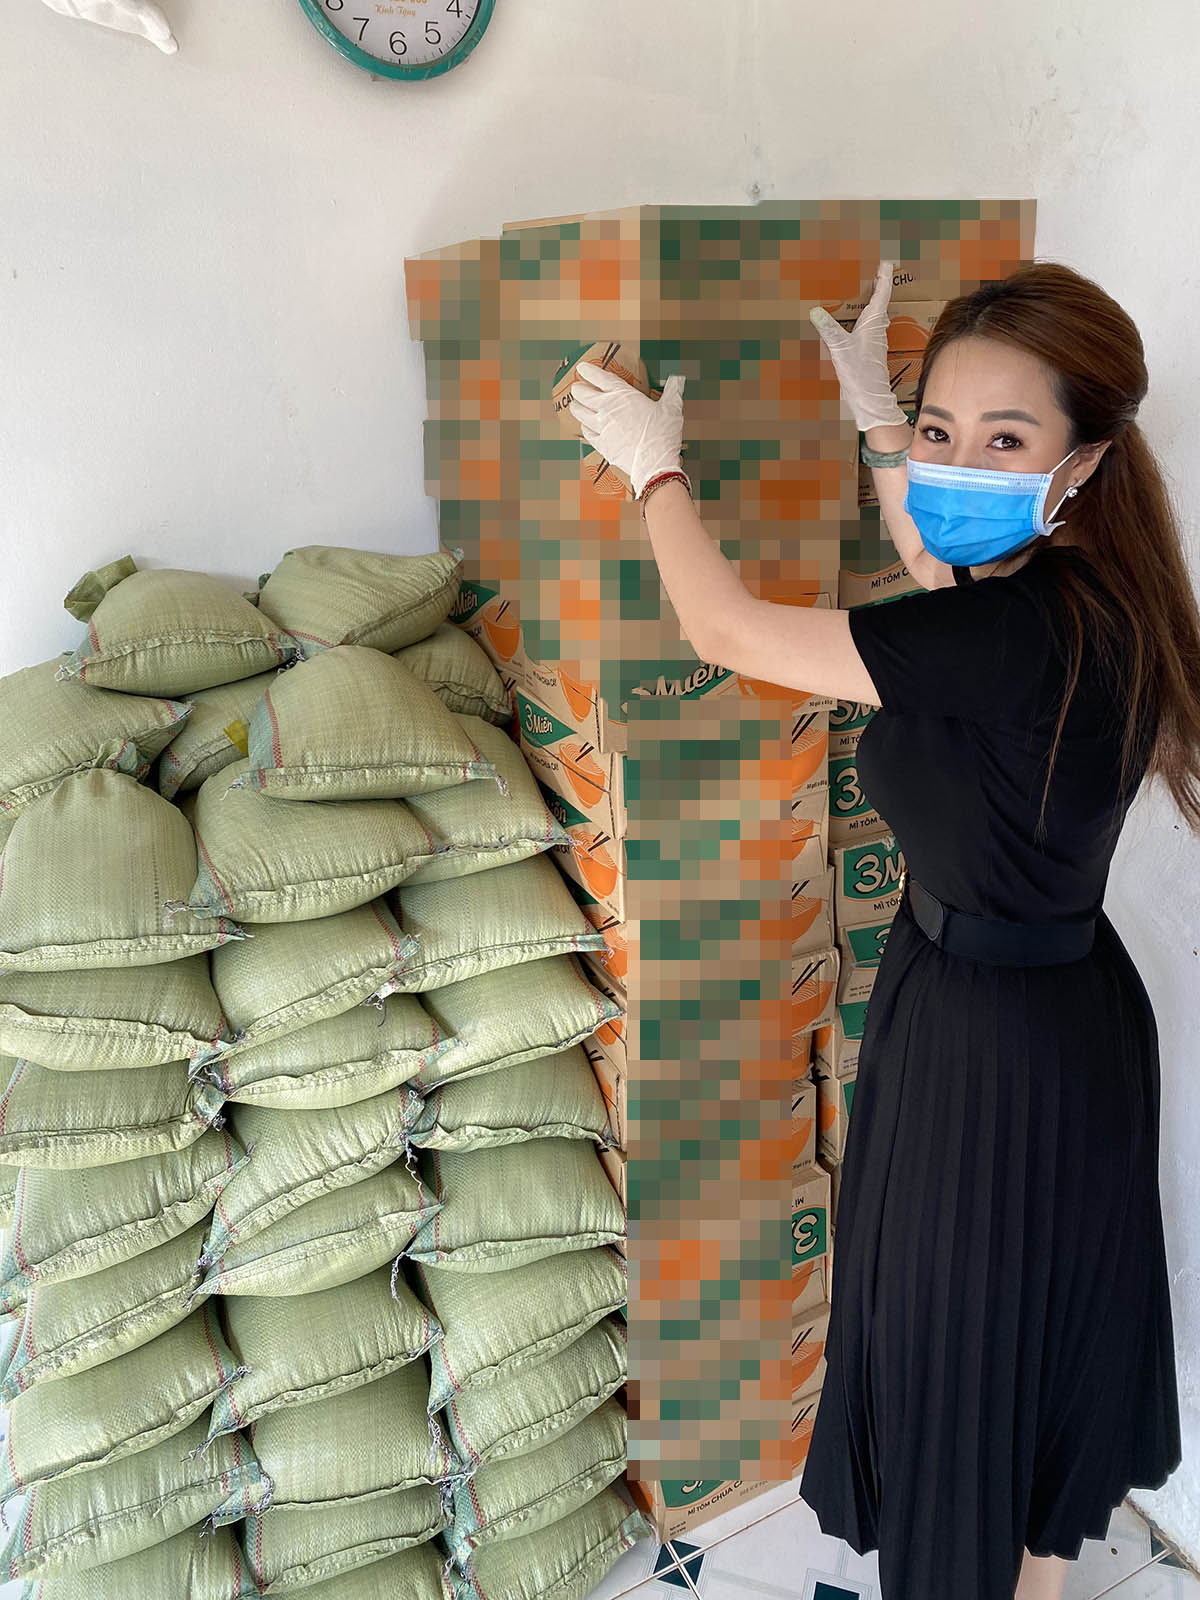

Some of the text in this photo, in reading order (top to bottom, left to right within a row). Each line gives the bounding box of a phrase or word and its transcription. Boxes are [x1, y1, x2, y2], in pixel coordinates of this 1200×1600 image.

[446, 0, 463, 18] 4
[353, 17, 370, 41] 7
[425, 21, 442, 45] 5
[389, 31, 407, 56] 6
[892, 273, 916, 286] CHU
[836, 766, 866, 811] 3
[793, 1213, 819, 1255] 3
[711, 1487, 734, 1504] CHUA
